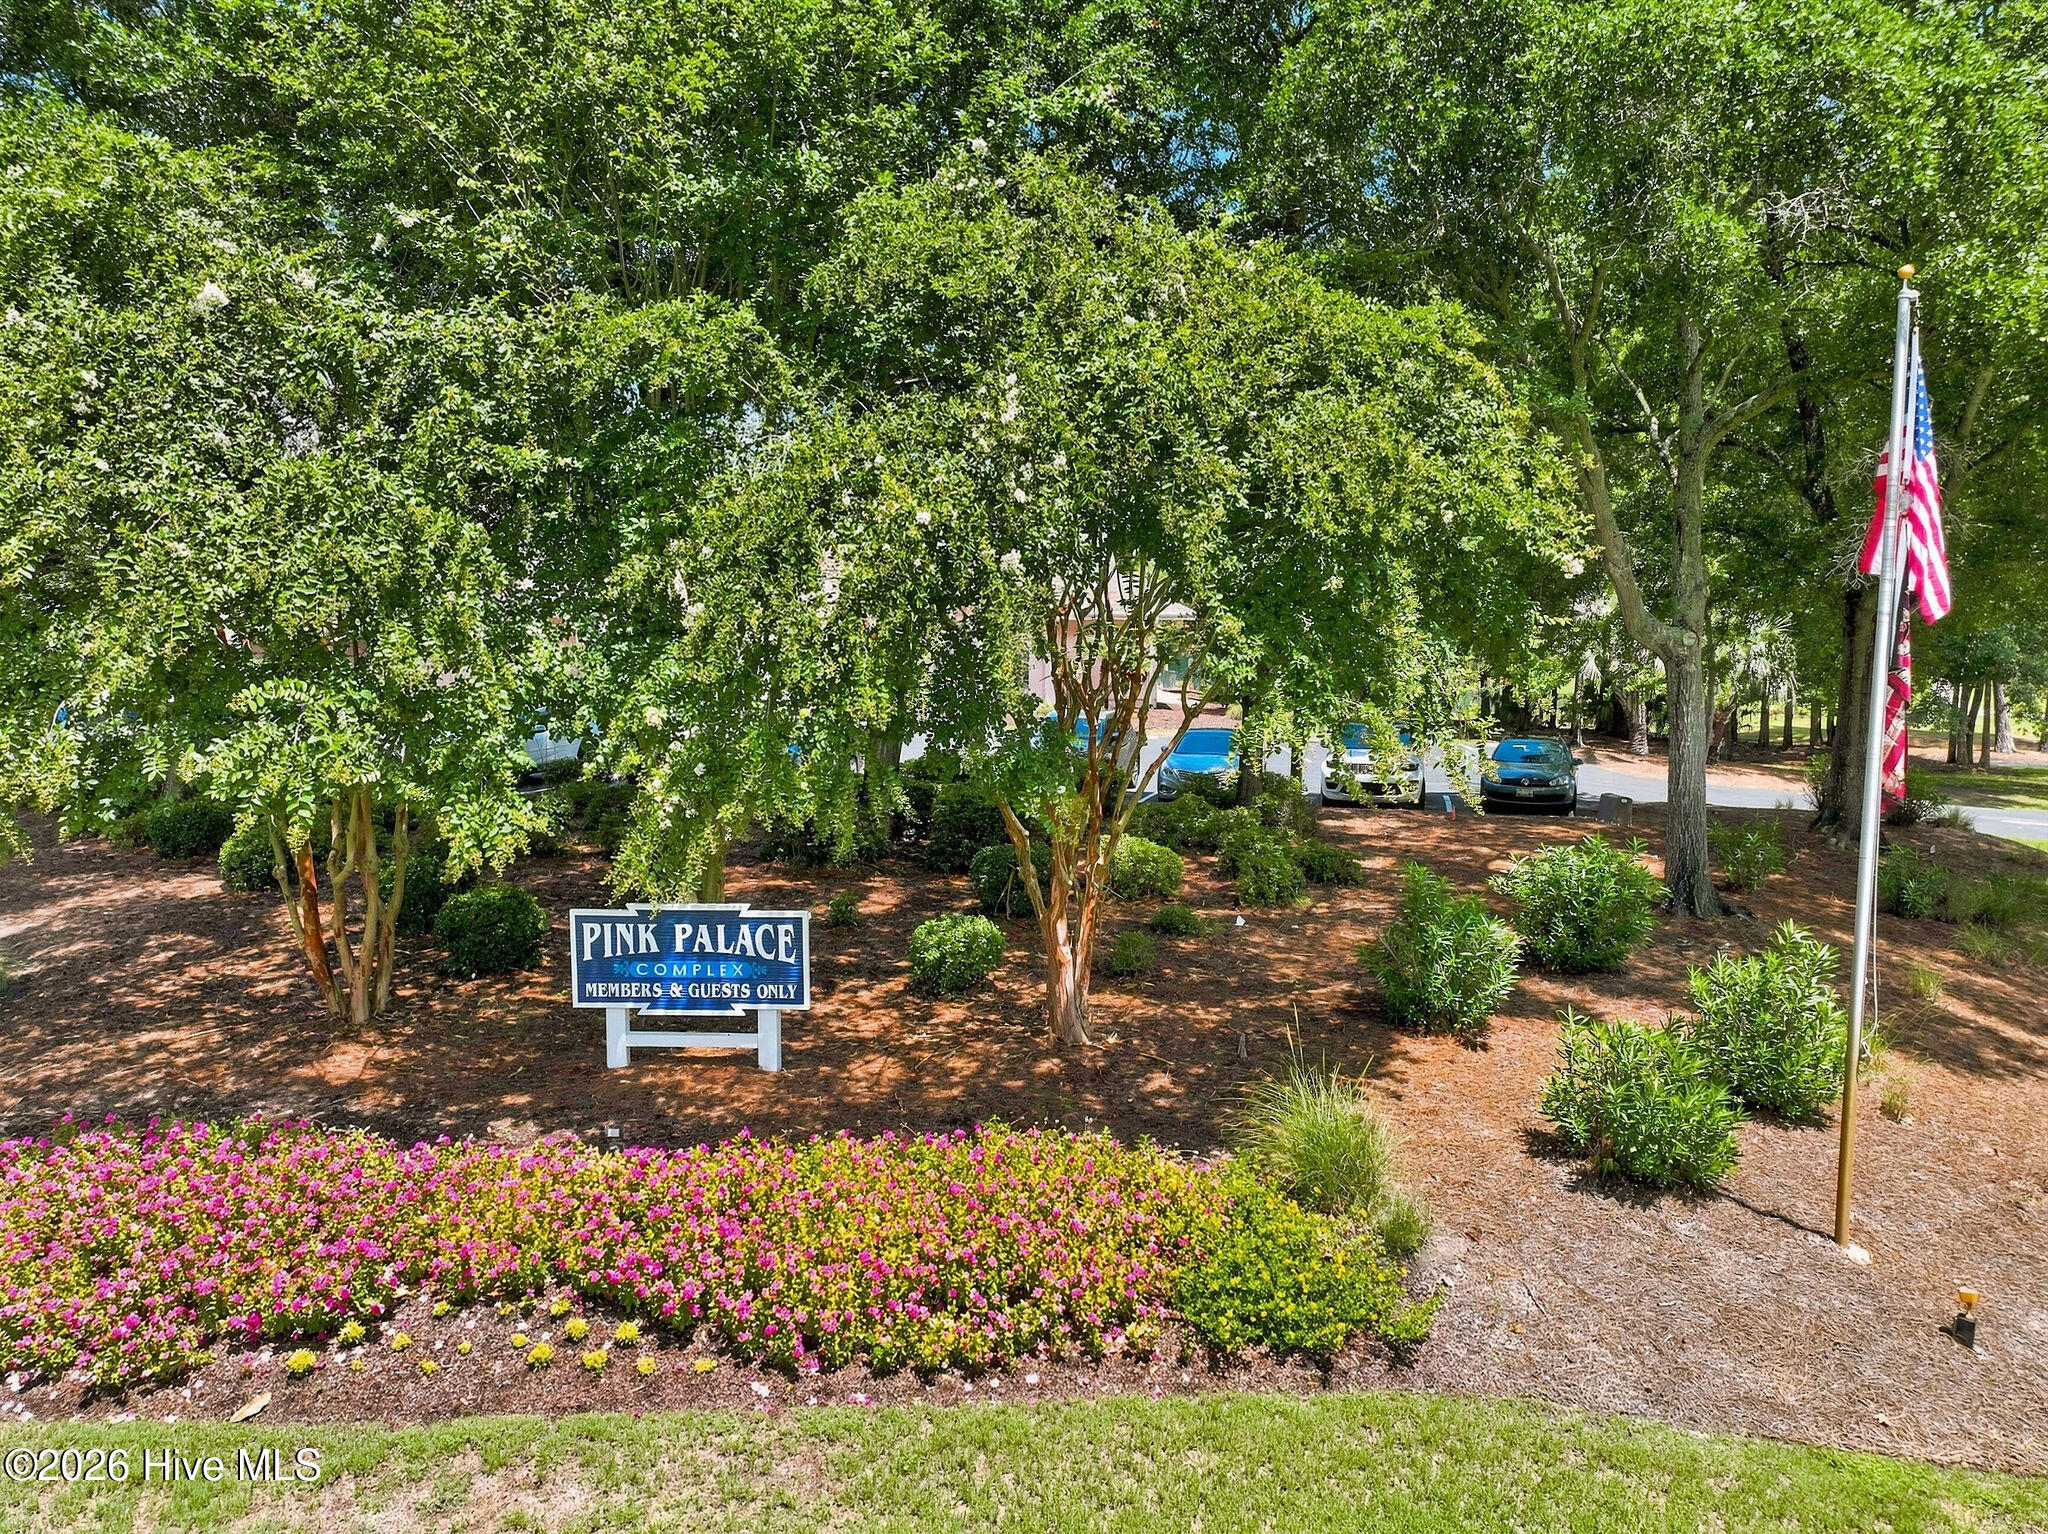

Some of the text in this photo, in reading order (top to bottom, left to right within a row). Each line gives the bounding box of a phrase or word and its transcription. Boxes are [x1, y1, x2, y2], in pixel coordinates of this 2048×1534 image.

[582, 923, 797, 964] PINK PALACE
[636, 963, 744, 976] COMPLEX
[585, 983, 798, 999] MEMBERS & GUESTS ONLY
